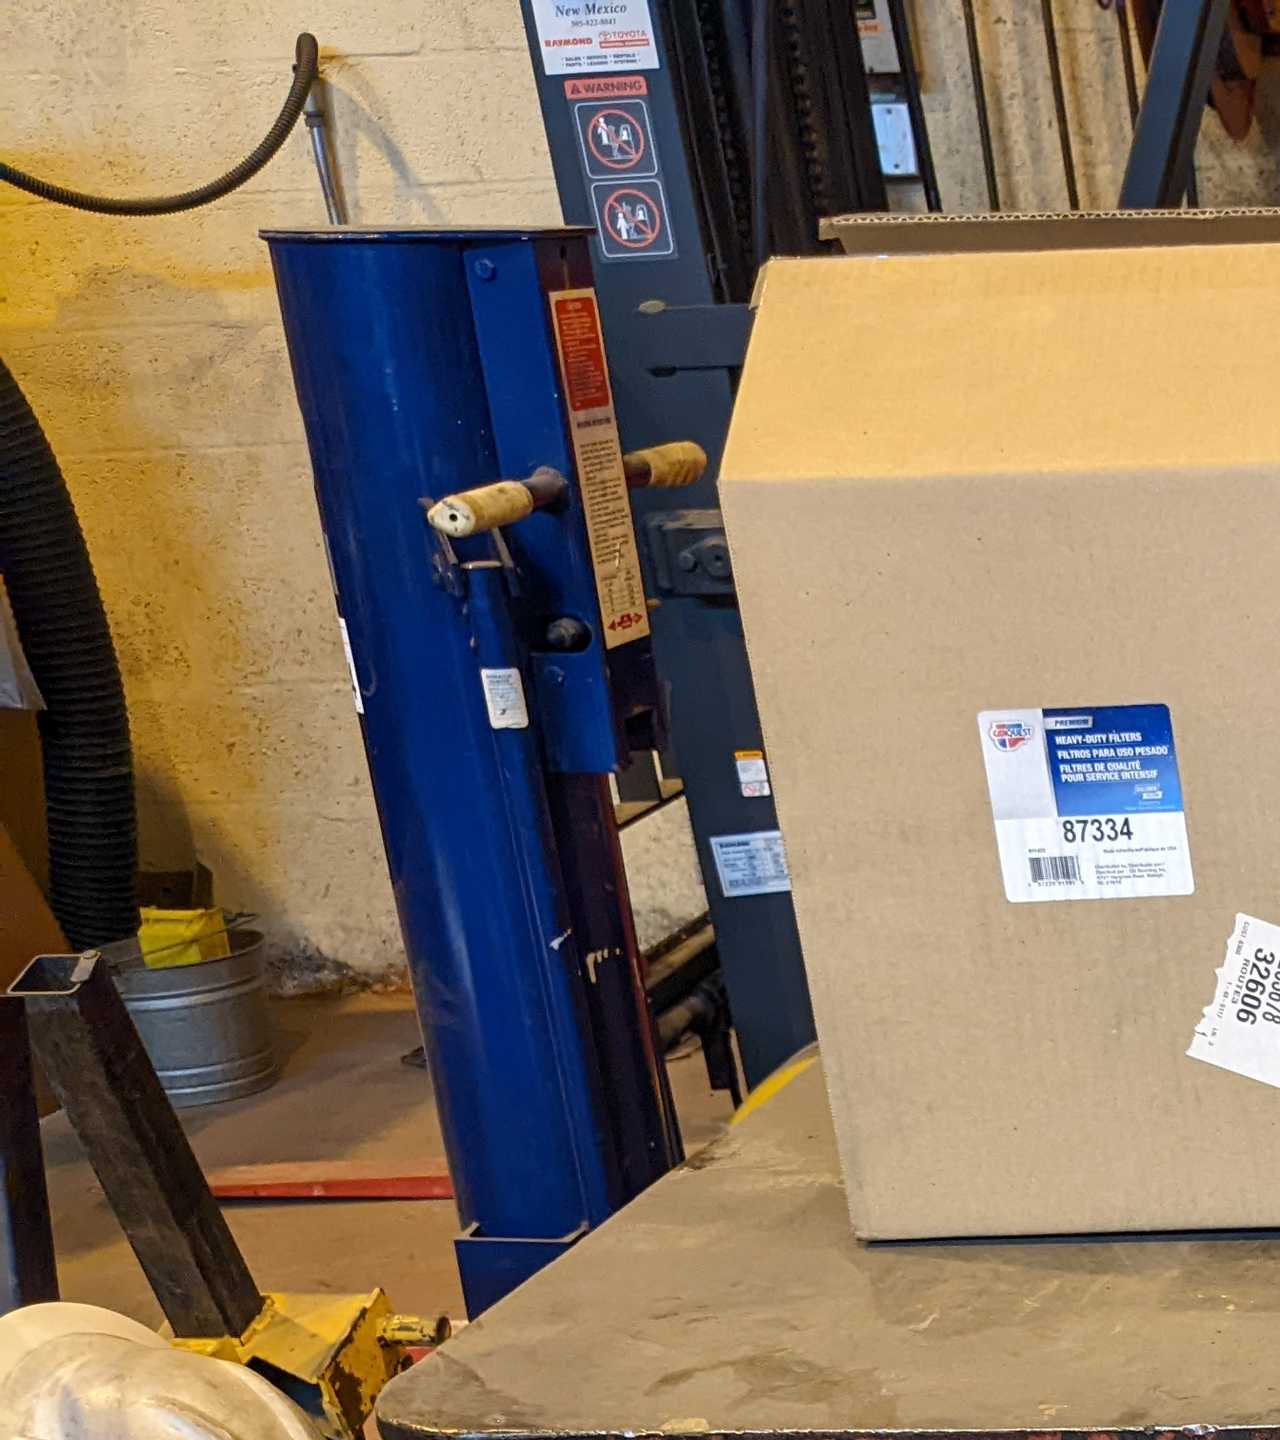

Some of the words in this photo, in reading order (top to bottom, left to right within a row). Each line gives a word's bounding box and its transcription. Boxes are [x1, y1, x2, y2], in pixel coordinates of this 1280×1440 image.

[555, 5, 580, 17] New
[585, 3, 628, 16] Mexico
[613, 30, 647, 40] TOYOTA
[544, 37, 593, 47] RAYMOND
[583, 81, 641, 93] WARNING
[1055, 733, 1107, 745] HEAVY-DUTY
[1109, 732, 1142, 742] FILTERS
[1058, 750, 1091, 760] FILTROS
[1093, 748, 1115, 758] PARA
[1117, 748, 1134, 757] USO
[1135, 746, 1168, 756] PESADO
[1060, 763, 1092, 773] FILTRES
[1094, 762, 1105, 771] DE
[1061, 773, 1084, 782] POUR
[1086, 771, 1119, 782] SERVICE
[1121, 769, 1158, 780] INTENSIF
[1062, 817, 1133, 843] 87334
[1236, 948, 1275, 1025] 32606
